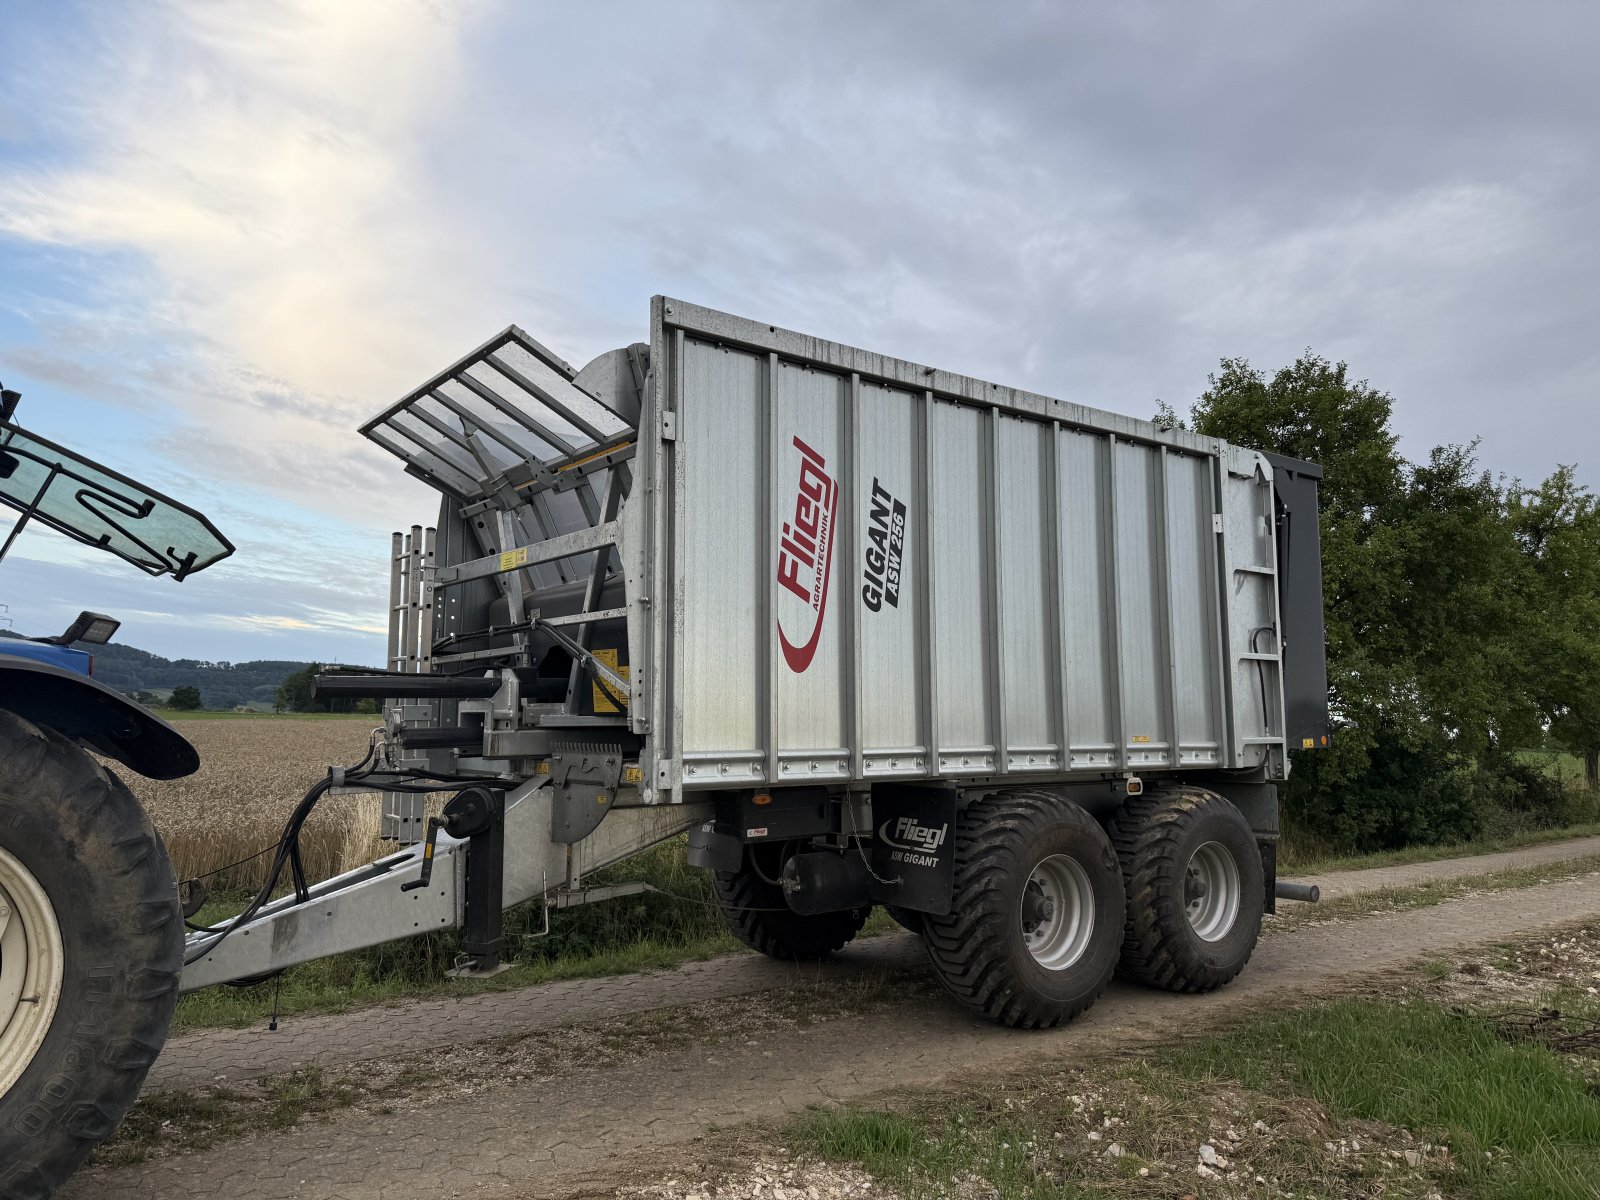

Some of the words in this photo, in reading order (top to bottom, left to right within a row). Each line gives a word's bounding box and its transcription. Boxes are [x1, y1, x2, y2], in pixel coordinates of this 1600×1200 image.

[777, 435, 832, 604] Fliegl
[890, 512, 904, 550] 256
[812, 512, 829, 612] AGRARTECHNIK
[862, 476, 891, 613] GIGANT
[886, 549, 900, 597] ASW
[895, 816, 948, 848] Fliegl
[891, 851, 903, 862] ASW
[903, 852, 940, 868] GIGANT
